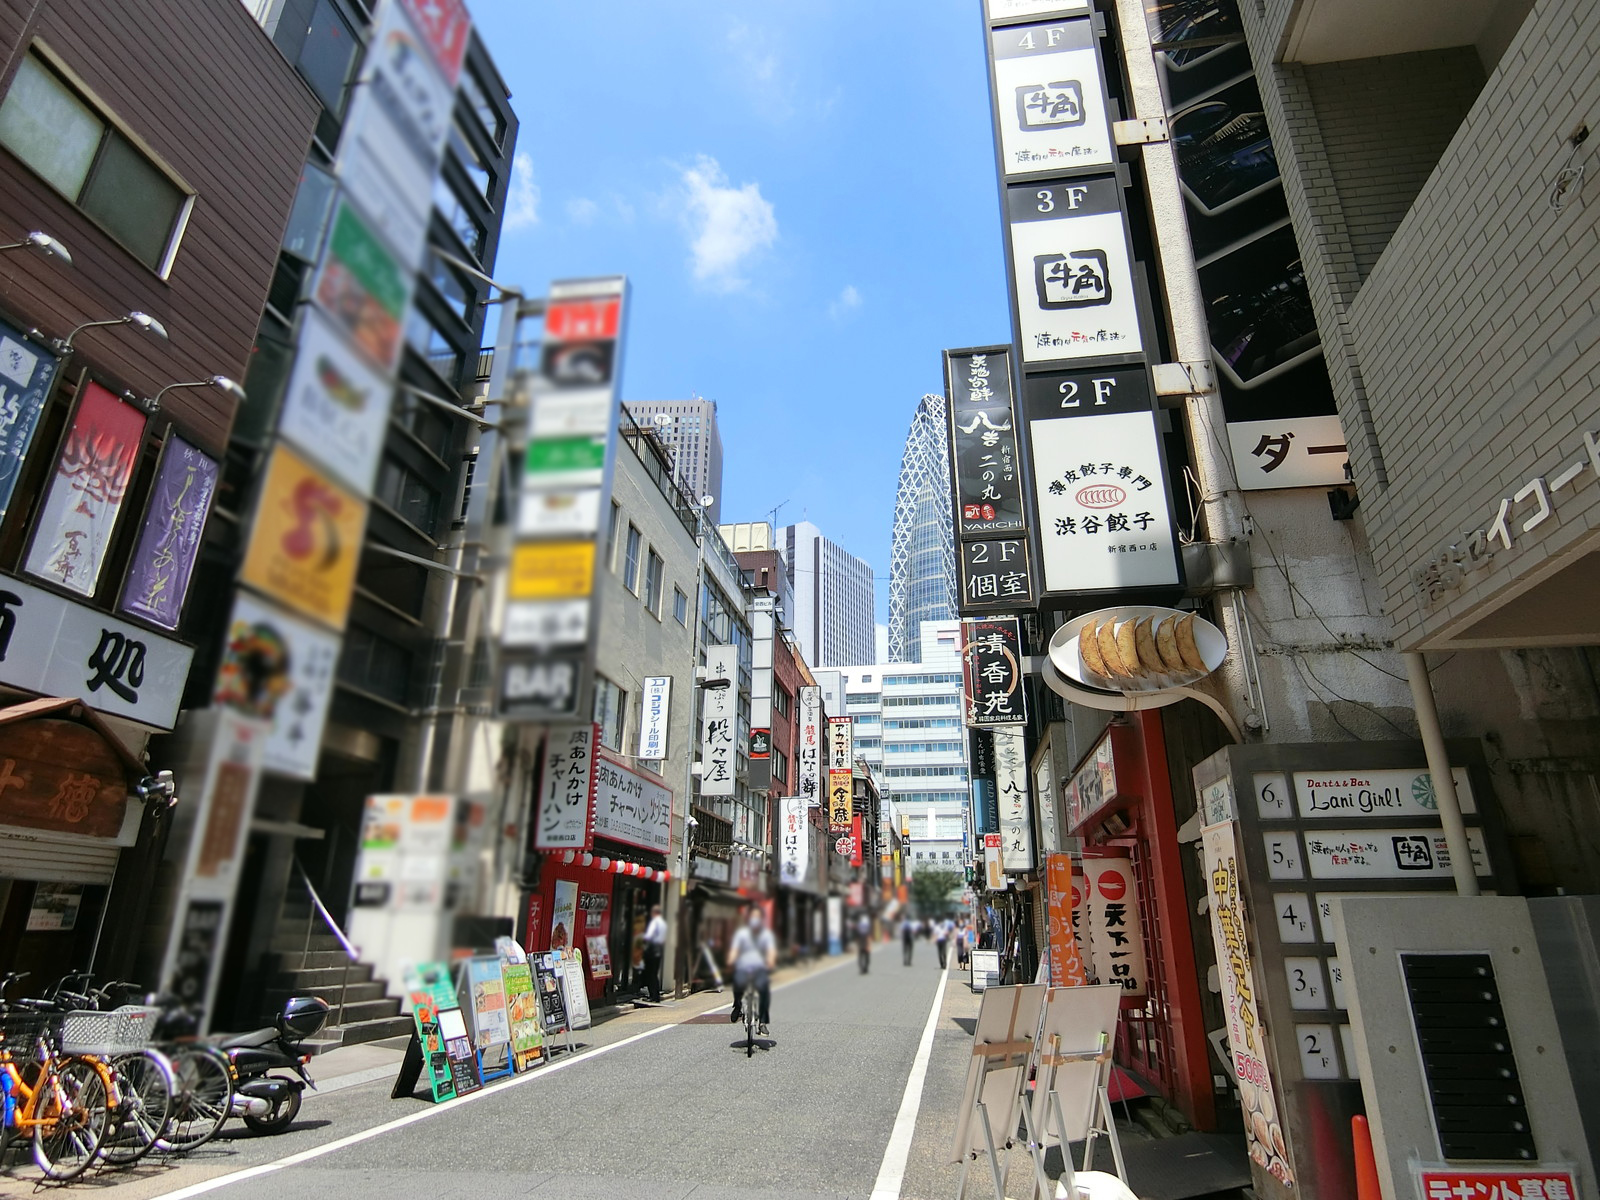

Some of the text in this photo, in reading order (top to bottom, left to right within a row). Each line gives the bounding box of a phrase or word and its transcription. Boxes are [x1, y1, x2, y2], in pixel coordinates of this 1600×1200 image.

[1026, 92, 1079, 118] 牛角
[1046, 262, 1104, 295] 牛角
[978, 454, 1001, 500] 二の丸
[1001, 445, 1013, 481] 新宿西口
[964, 520, 1022, 530] YAKICHI
[1054, 511, 1155, 536] 渋谷餃子
[1108, 542, 1157, 553] 新宿西口店
[967, 571, 1028, 599] 個室
[714, 660, 727, 713] 串ぷら
[978, 632, 1013, 715] 清香苑
[645, 749, 660, 757] 2F
[704, 718, 732, 782] 段々屋
[834, 723, 846, 768] アカマル屋
[565, 730, 589, 806] 肉あんかけ
[598, 765, 643, 799] 肉あんかけ
[543, 753, 566, 832] チャーハン
[609, 794, 649, 824] チャーハン
[833, 786, 850, 823] 金の蔵
[1310, 789, 1355, 811] Lani
[1009, 811, 1026, 852] 二の丸
[1399, 842, 1429, 864] 牛角
[1104, 903, 1138, 989] 天下一品
